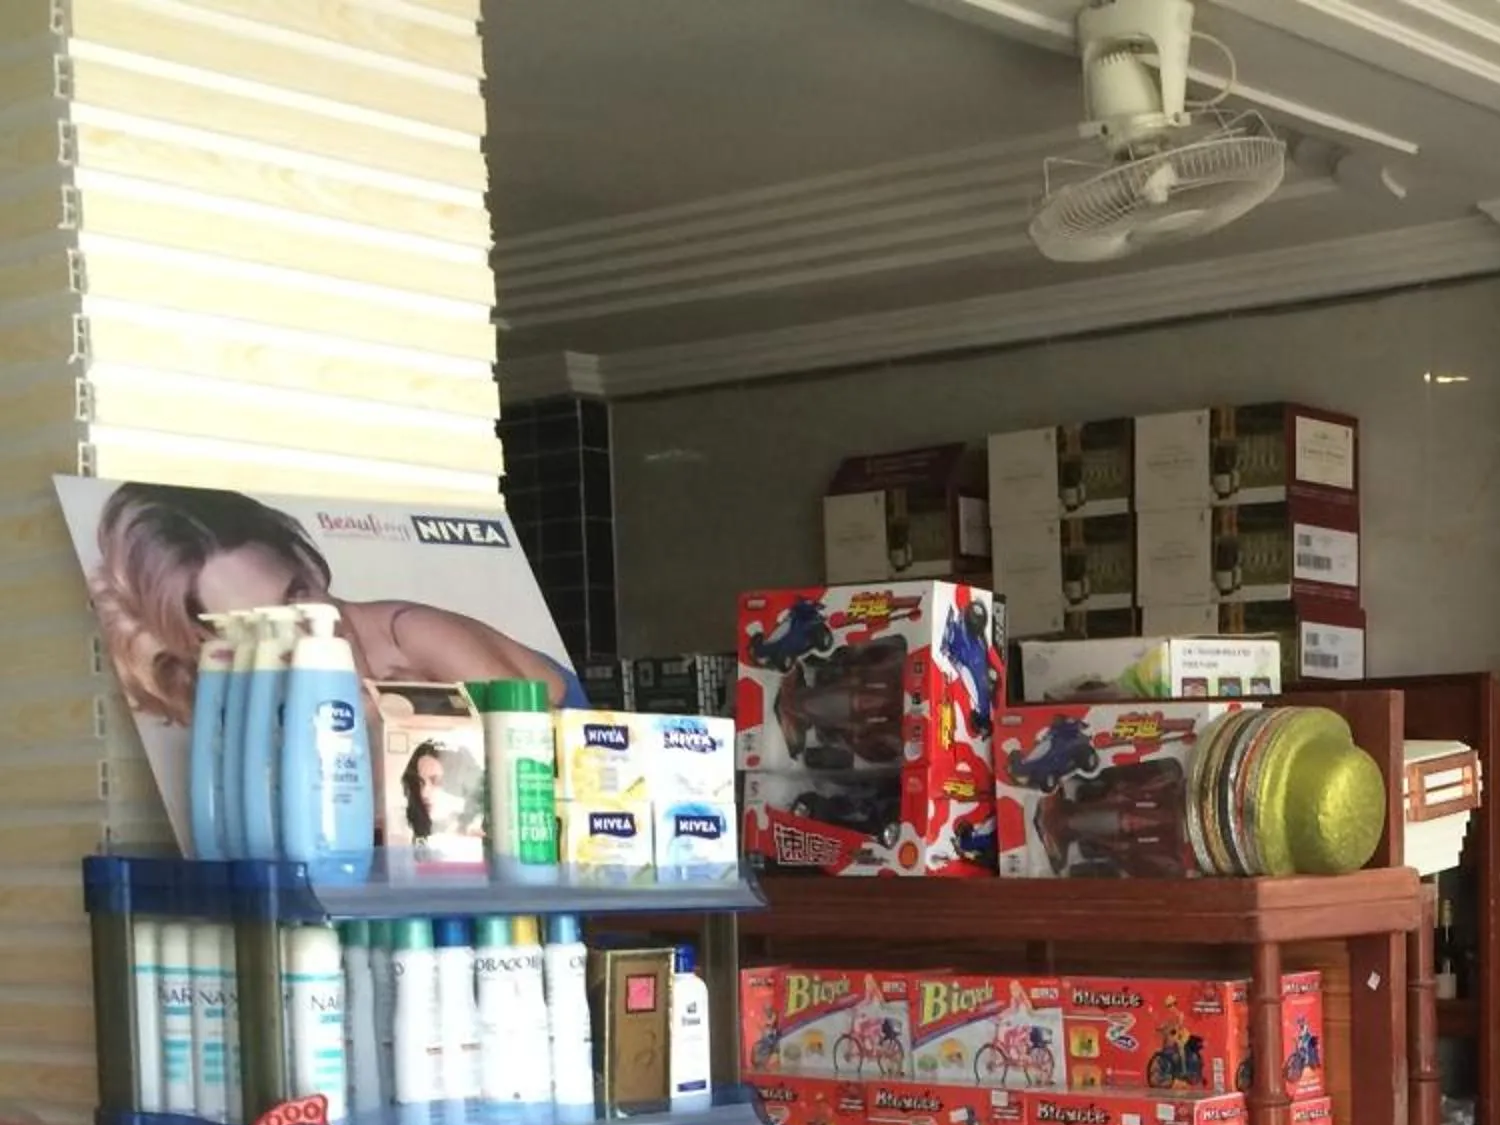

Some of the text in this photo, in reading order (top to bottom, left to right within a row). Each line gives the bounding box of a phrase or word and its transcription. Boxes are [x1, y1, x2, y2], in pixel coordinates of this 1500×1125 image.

[416, 519, 506, 546] NIVEA
[587, 729, 626, 745] NIVEA
[592, 817, 633, 832] NIVEA
[679, 820, 718, 834] NIVEA
